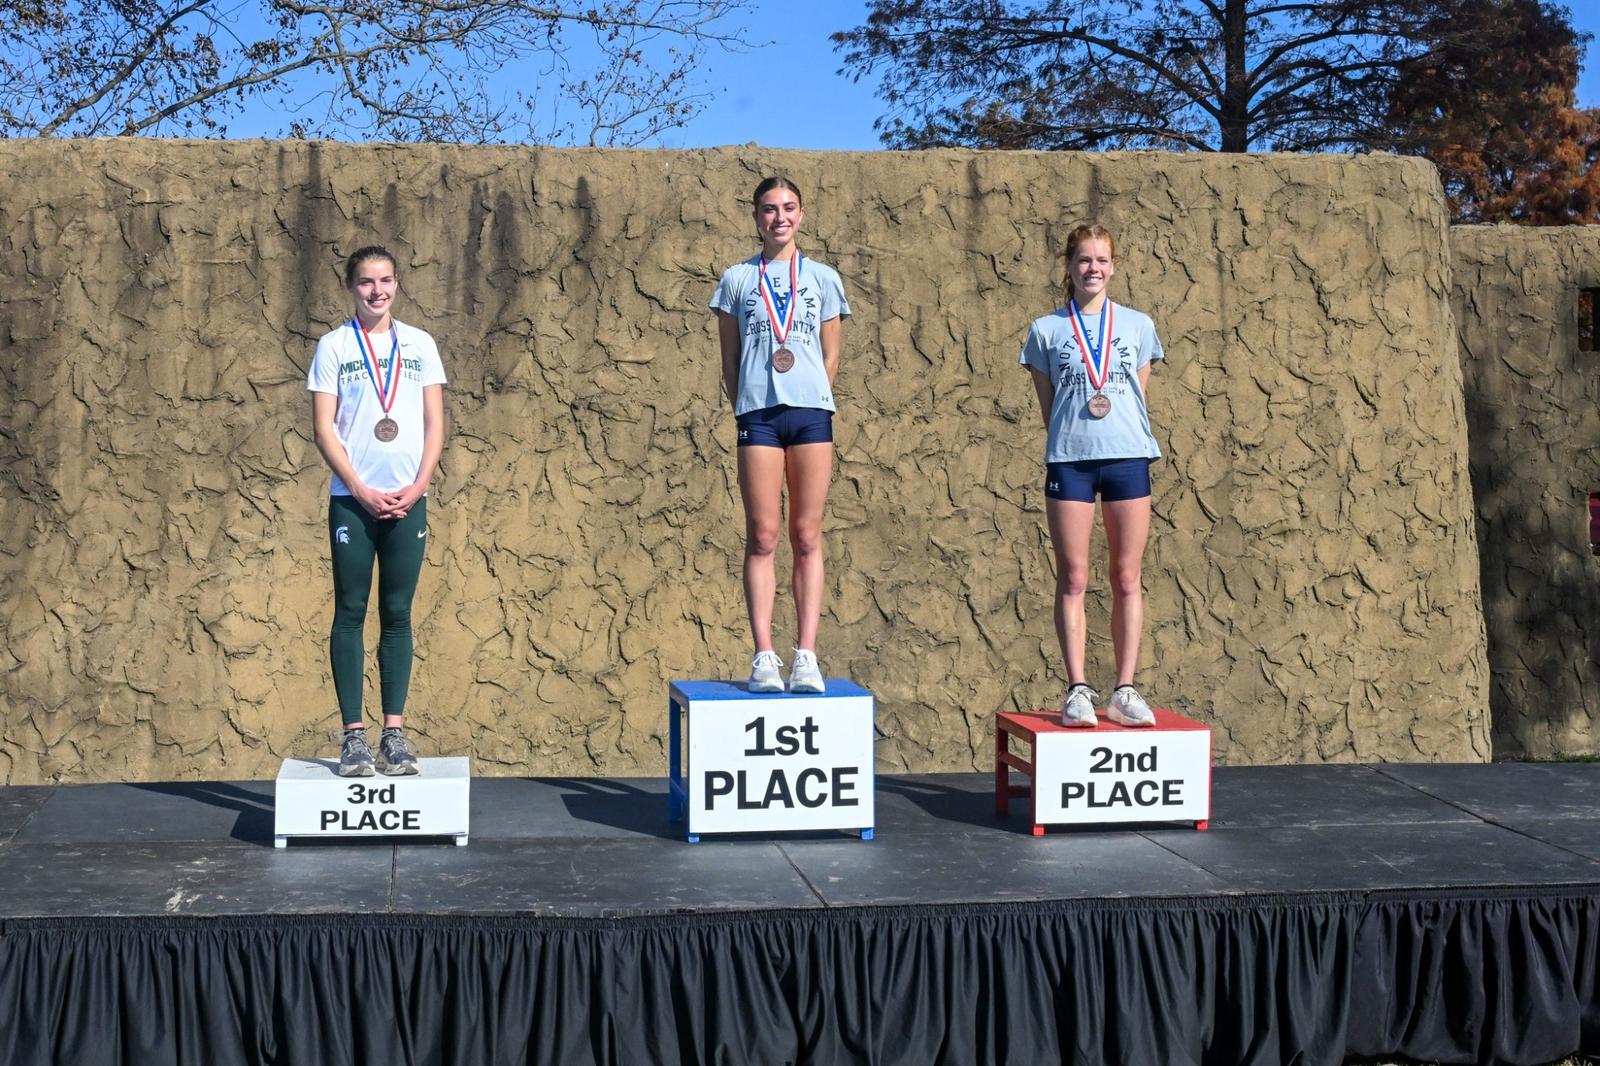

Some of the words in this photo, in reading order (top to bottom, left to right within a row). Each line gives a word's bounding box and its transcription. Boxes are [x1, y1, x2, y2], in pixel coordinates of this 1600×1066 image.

[744, 277, 781, 320] NOTE
[794, 284, 816, 320] AME
[340, 358, 390, 375] MICHAN
[1110, 337, 1132, 370] AME
[341, 371, 368, 385] TRAC
[1105, 372, 1131, 385] NTRY
[744, 716, 819, 756] 1st
[1089, 745, 1157, 773] 2nd
[347, 783, 395, 805] 3rd
[704, 766, 859, 811] PLACE
[1061, 779, 1184, 809] PLACE
[320, 809, 421, 831] PLACE
